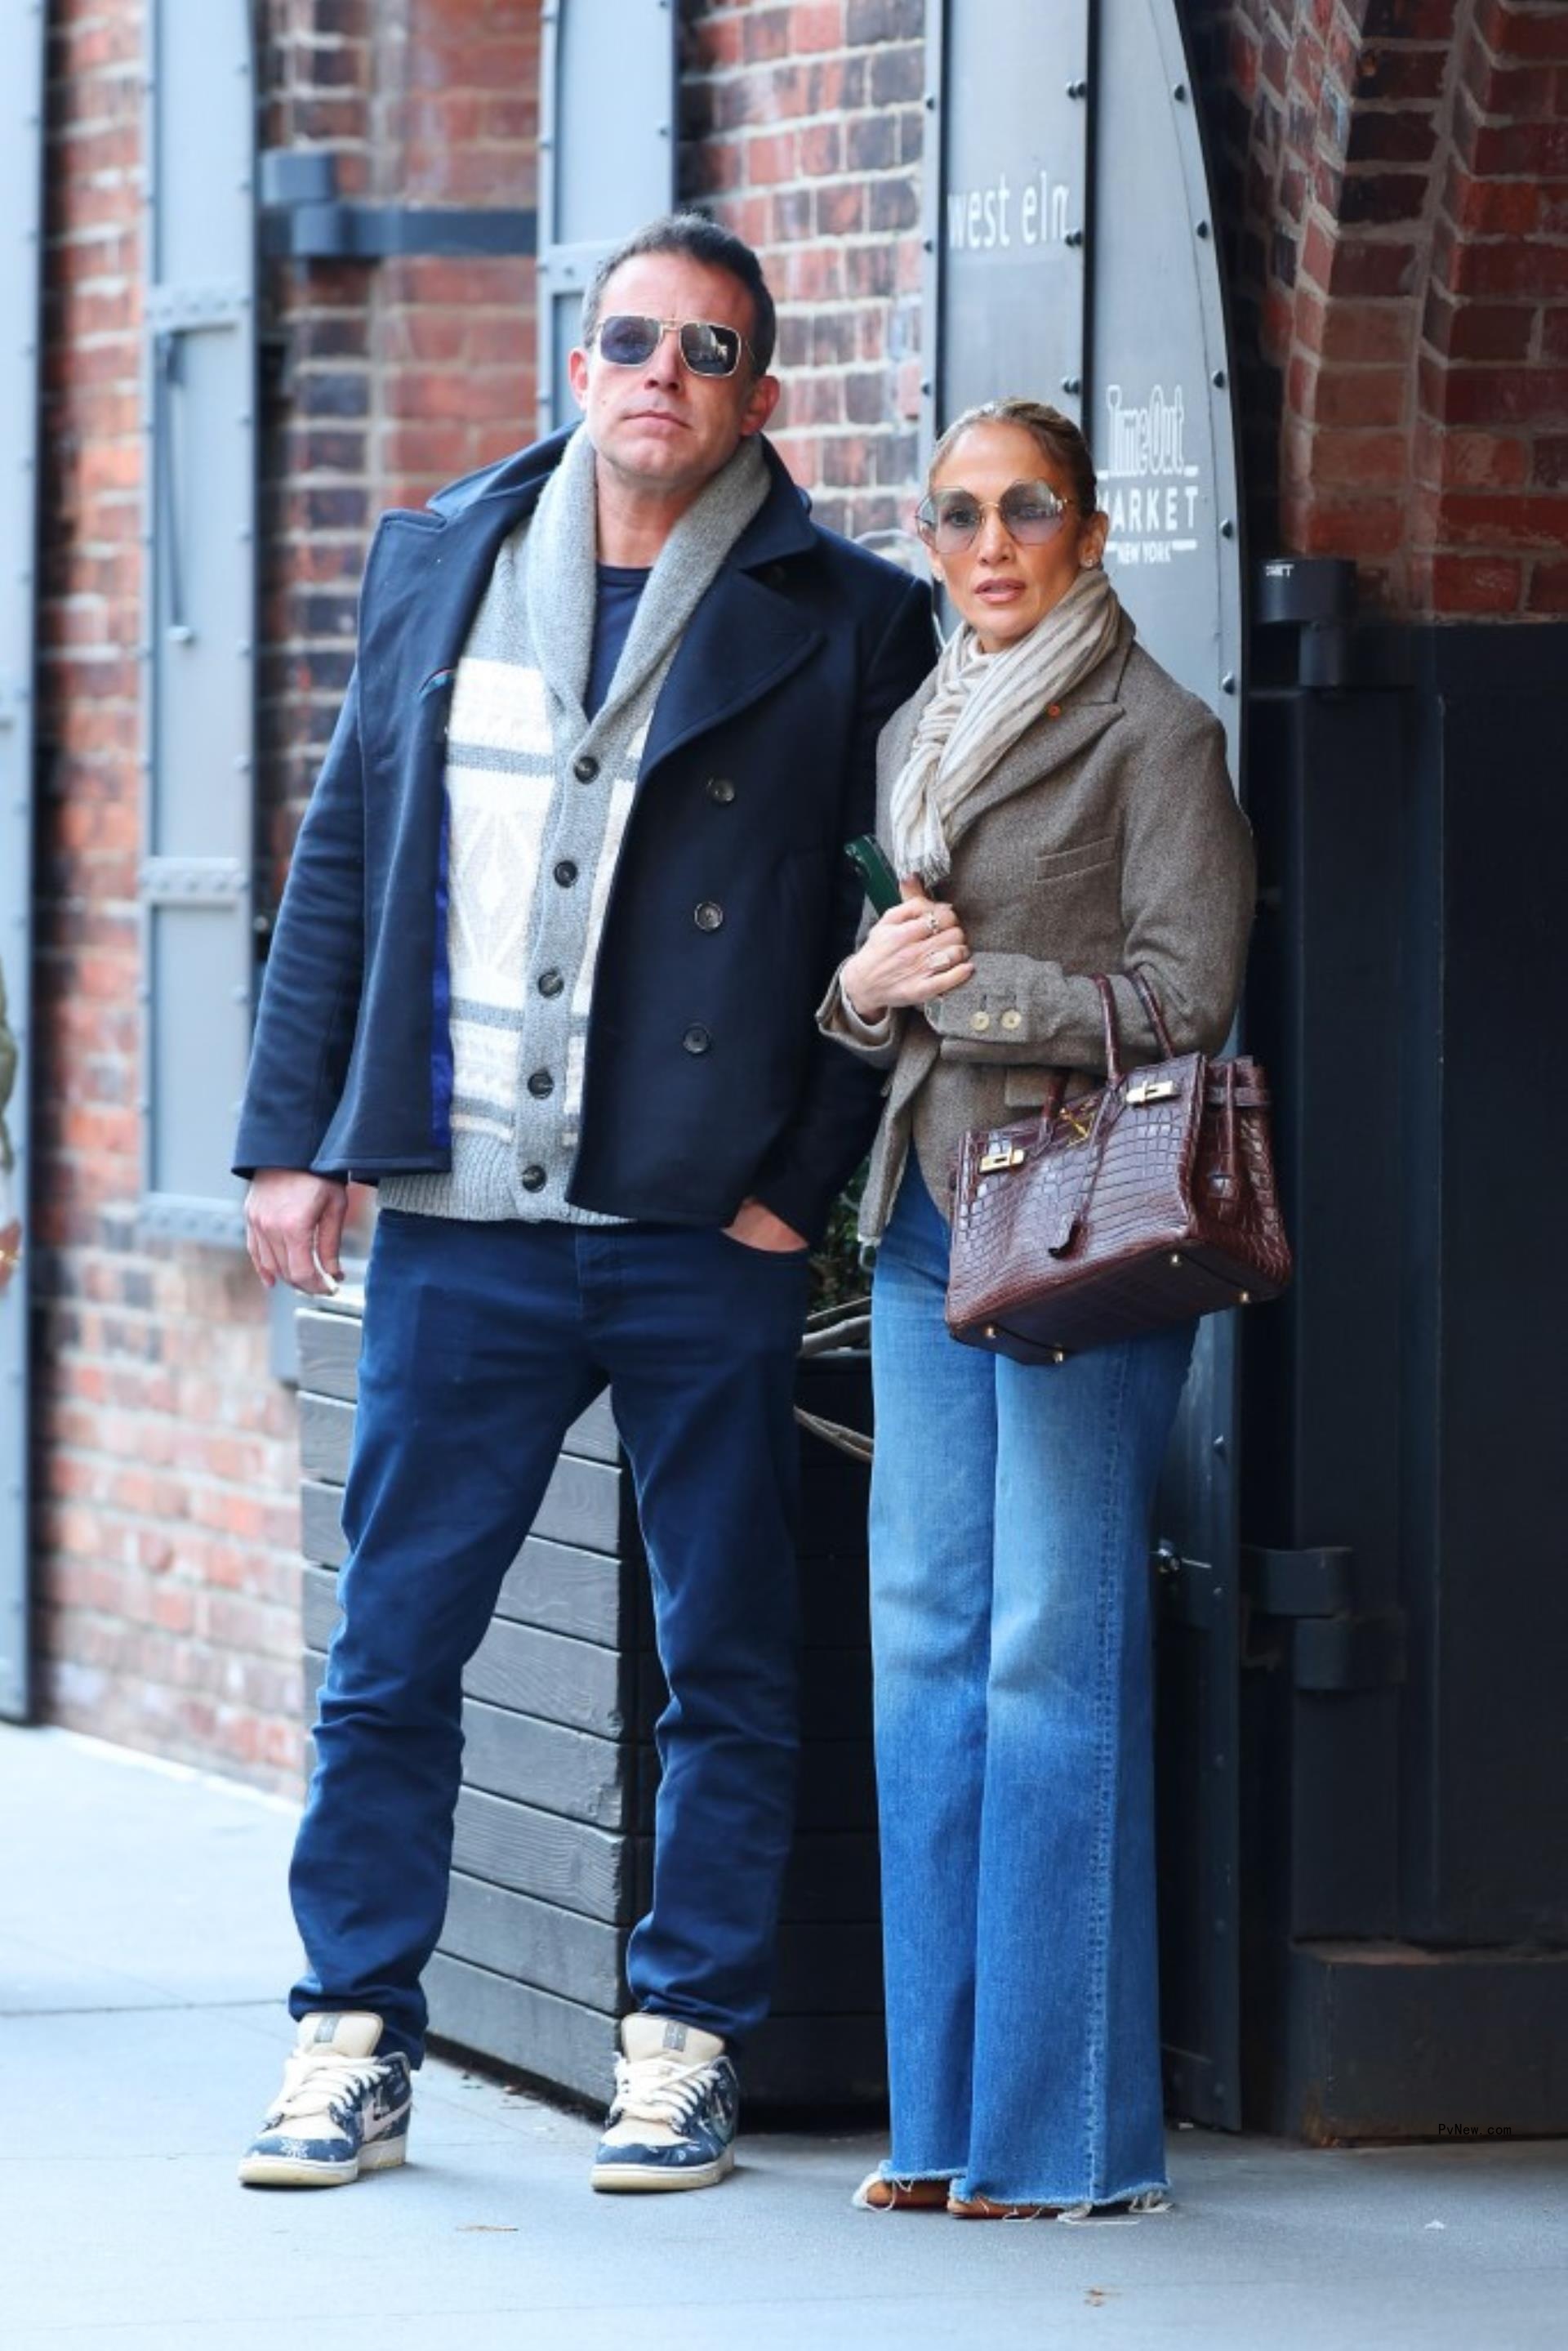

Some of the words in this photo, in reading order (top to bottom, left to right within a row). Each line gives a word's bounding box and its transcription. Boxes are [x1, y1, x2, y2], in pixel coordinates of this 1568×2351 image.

[947, 172, 1010, 248] west
[1117, 541, 1140, 564] NEW
[1142, 540, 1171, 564] YORK
